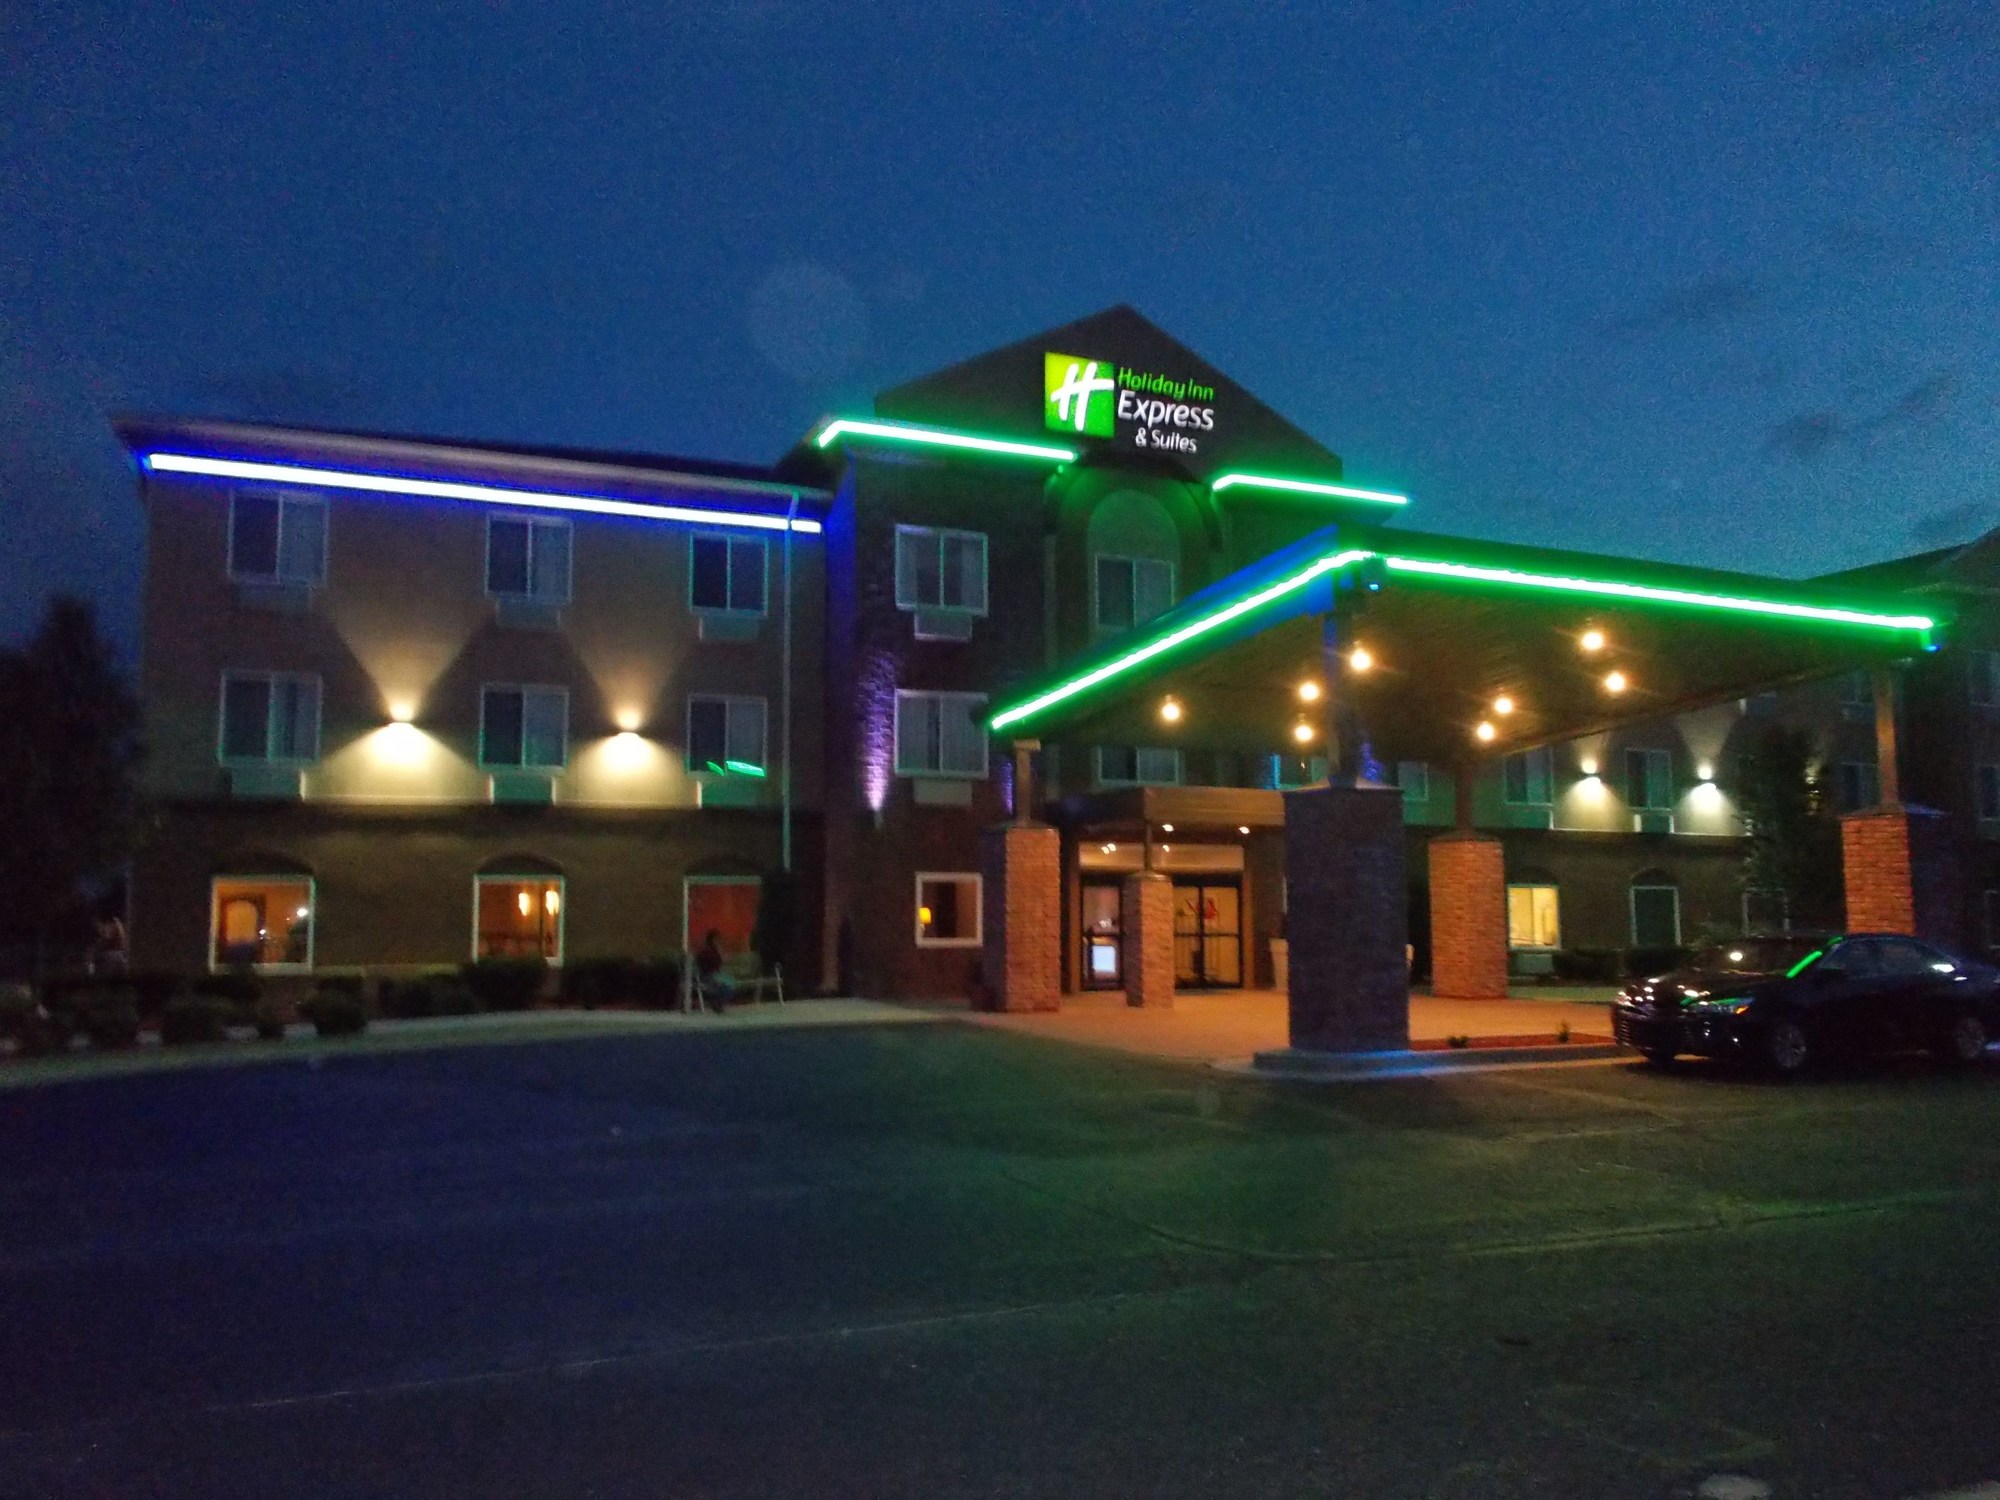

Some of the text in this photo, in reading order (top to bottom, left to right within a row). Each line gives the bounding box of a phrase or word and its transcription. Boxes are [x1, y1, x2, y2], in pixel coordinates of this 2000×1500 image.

[1050, 362, 1114, 431] H
[1118, 367, 1214, 400] Holiday Inn
[1118, 389, 1214, 431] Express
[1135, 427, 1197, 453] & Suites
